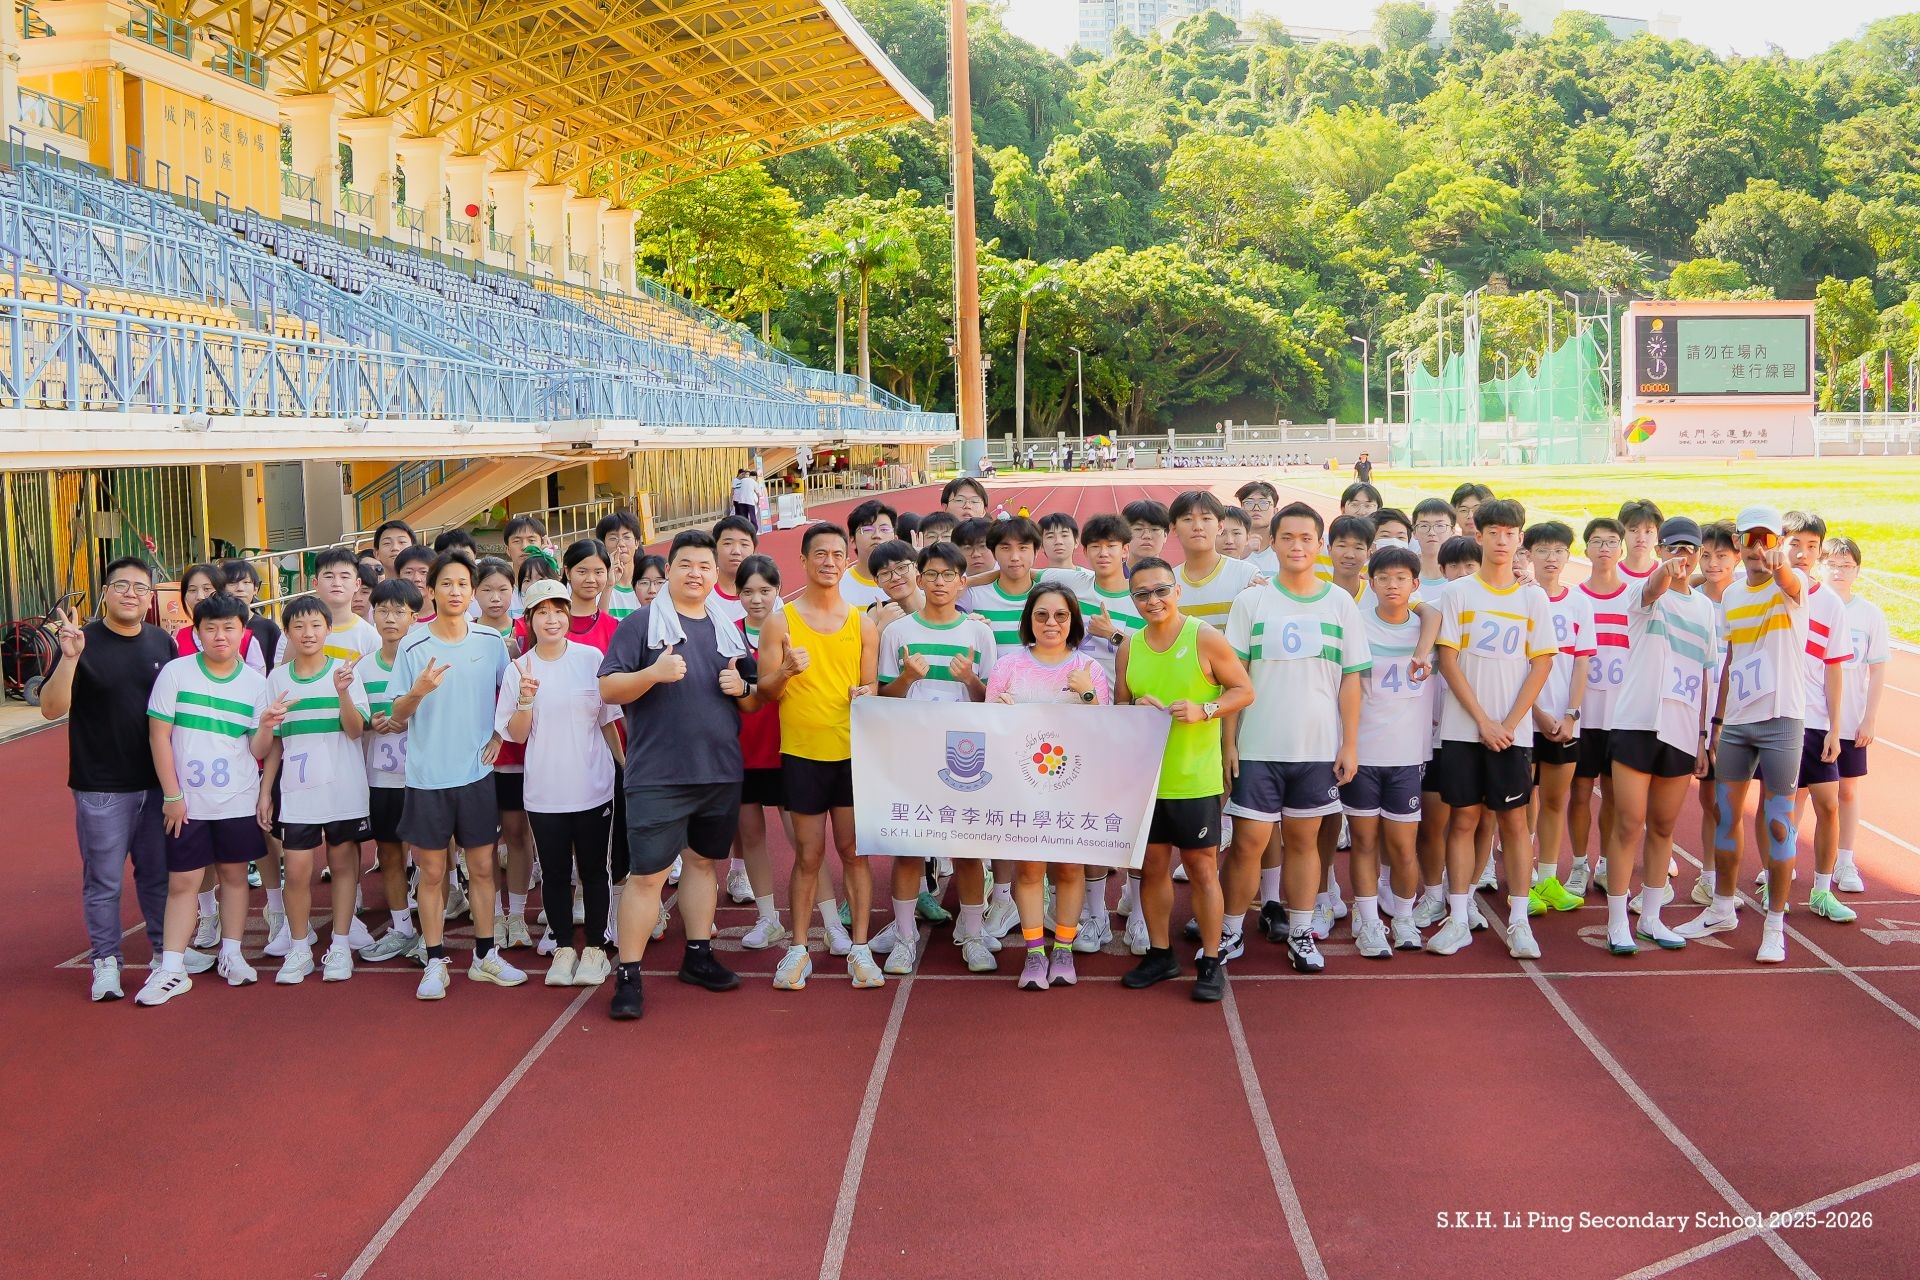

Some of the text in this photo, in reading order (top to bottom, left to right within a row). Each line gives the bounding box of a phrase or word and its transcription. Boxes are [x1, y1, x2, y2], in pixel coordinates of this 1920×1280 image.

[1731, 363, 1796, 379] 進行練習
[1282, 622, 1301, 653] 6
[1476, 620, 1519, 655] 20
[1587, 656, 1624, 685] 36
[1731, 658, 1761, 700] 27
[187, 758, 230, 787] 38
[289, 752, 308, 783] 7
[890, 802, 1123, 833] 聖公會李炳中學校友會
[880, 827, 1131, 849] S.K.H. Li Ping Secondary School Alumni Association
